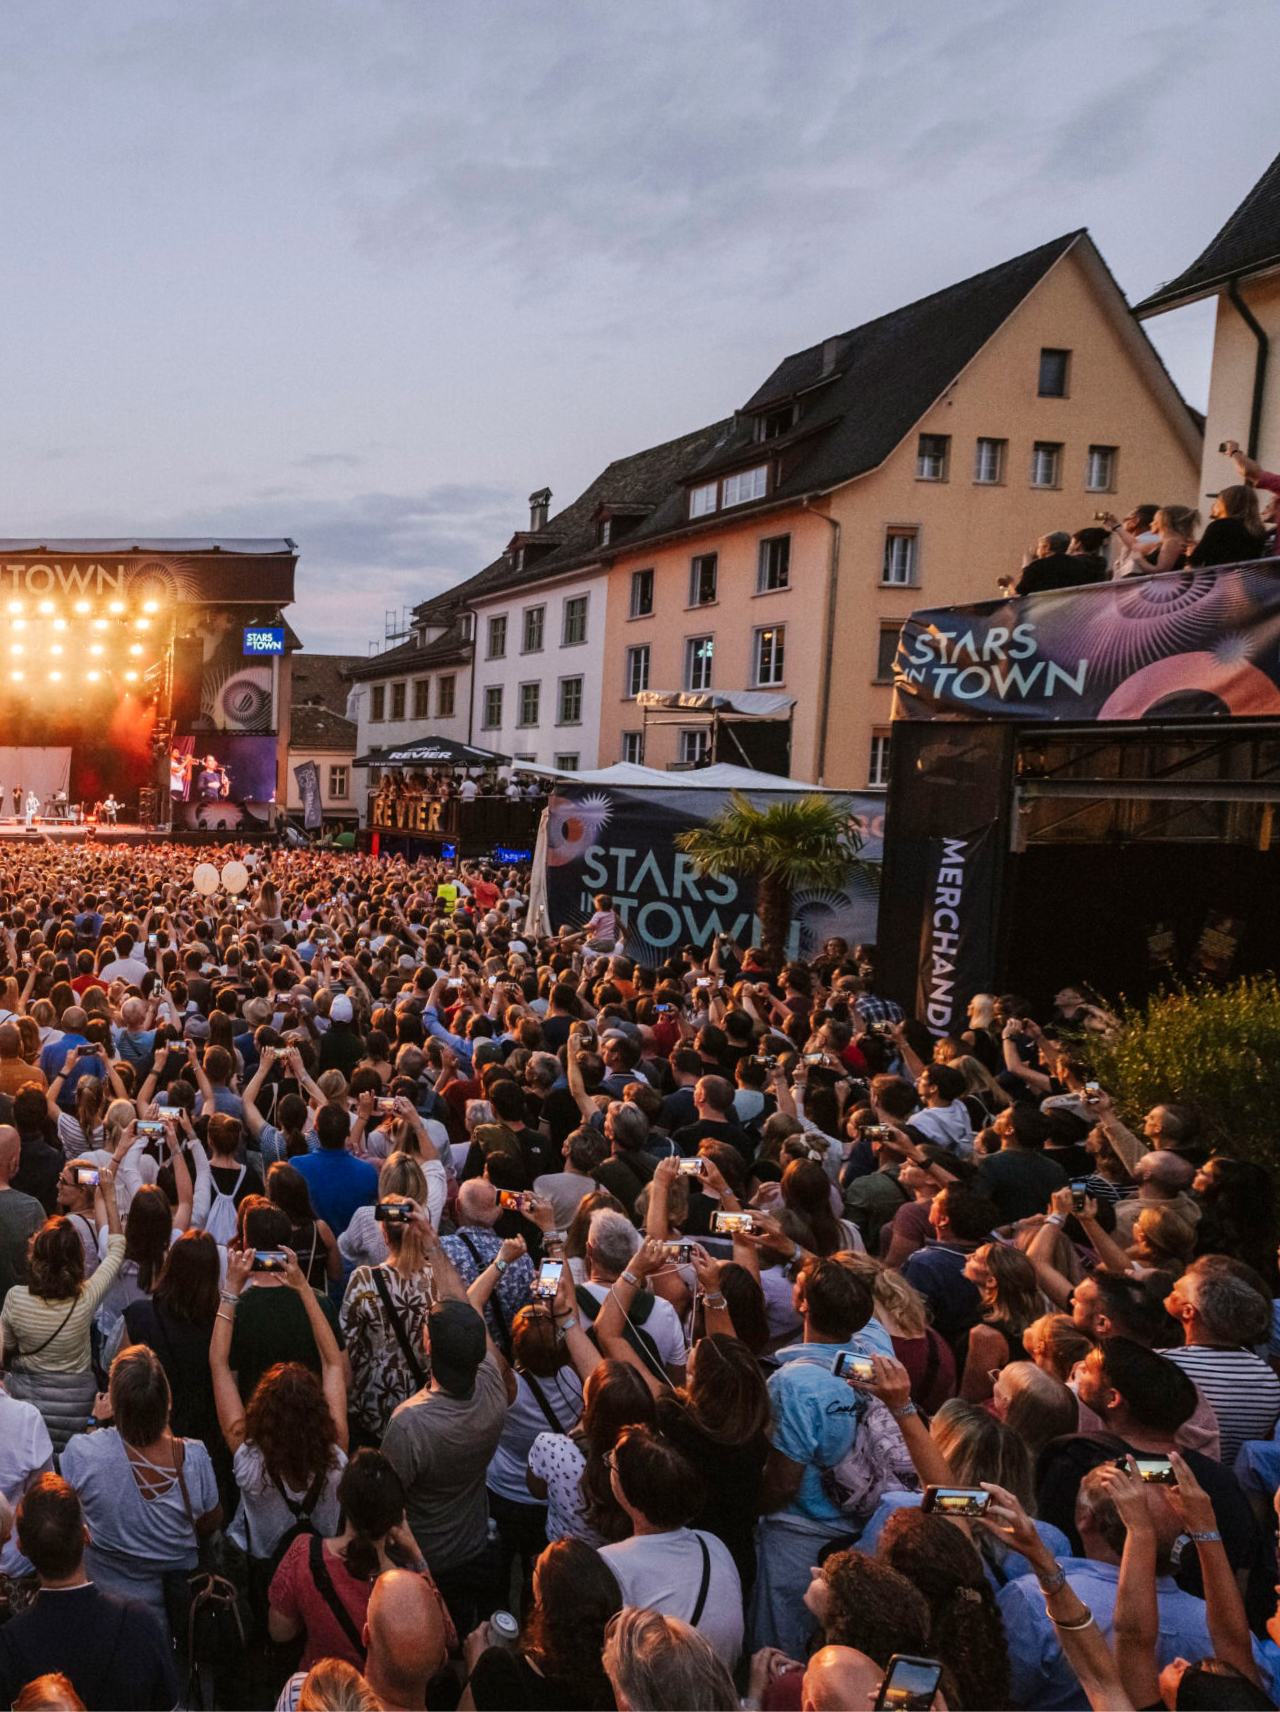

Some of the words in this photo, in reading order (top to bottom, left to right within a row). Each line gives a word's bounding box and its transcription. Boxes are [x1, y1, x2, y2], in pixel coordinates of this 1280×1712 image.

[7, 564, 125, 595] TOWN
[247, 633, 272, 641] STARS
[253, 641, 281, 650] TOWN
[910, 624, 1038, 665] STARS
[932, 659, 1088, 699] TOWN
[389, 751, 452, 759] REVIER
[373, 799, 441, 832] REVIER
[582, 845, 738, 904] STARS
[926, 837, 969, 1038] MERCHANDI
